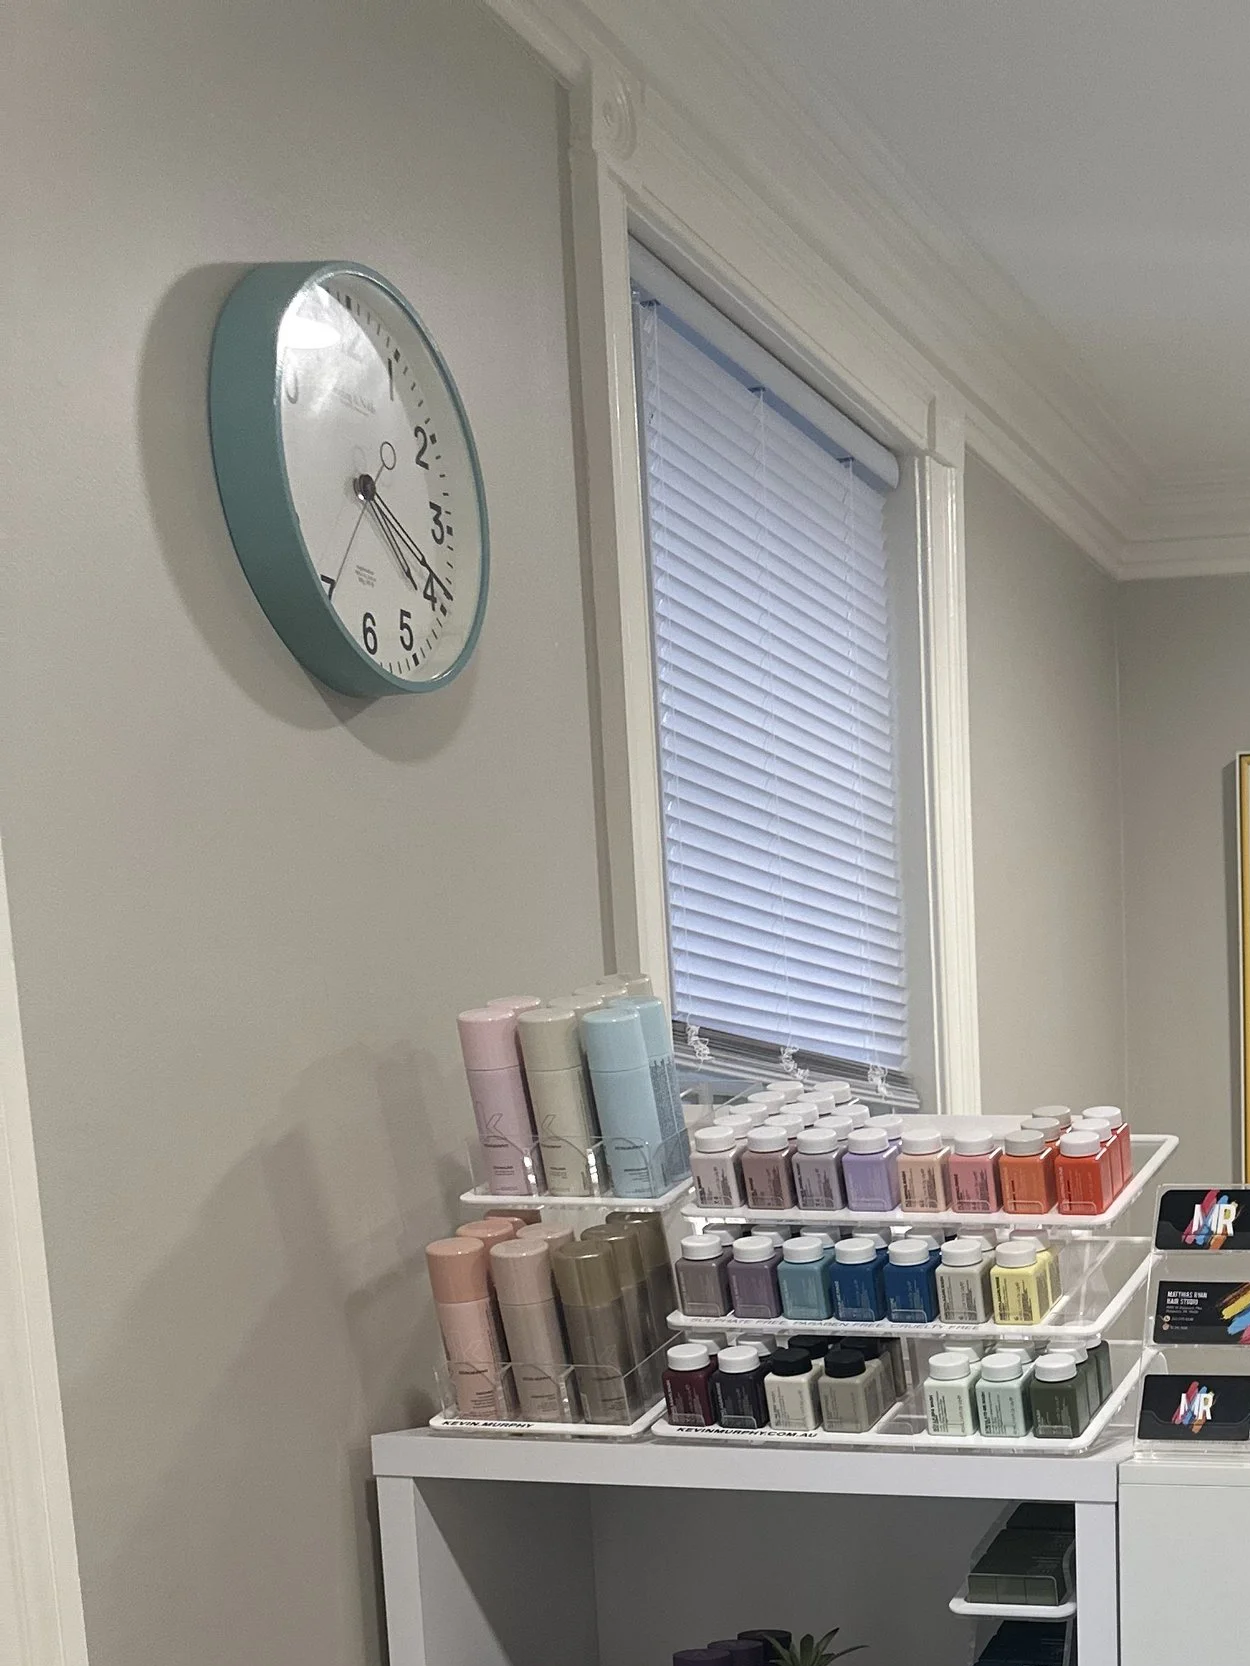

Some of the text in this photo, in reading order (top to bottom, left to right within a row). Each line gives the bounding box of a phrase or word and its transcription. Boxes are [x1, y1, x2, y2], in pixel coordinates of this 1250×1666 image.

[414, 425, 430, 470] 2
[429, 501, 445, 545] 3
[423, 572, 437, 611] 4
[363, 612, 378, 655] 6
[400, 608, 414, 651] 5
[1192, 1203, 1238, 1236] MR
[691, 1317, 750, 1325] SULPHATE
[1180, 1393, 1214, 1420] MR
[442, 1421, 535, 1429] KEVIN.MURPHY
[677, 1427, 818, 1438] KEVINMURPHY.COM.AU
